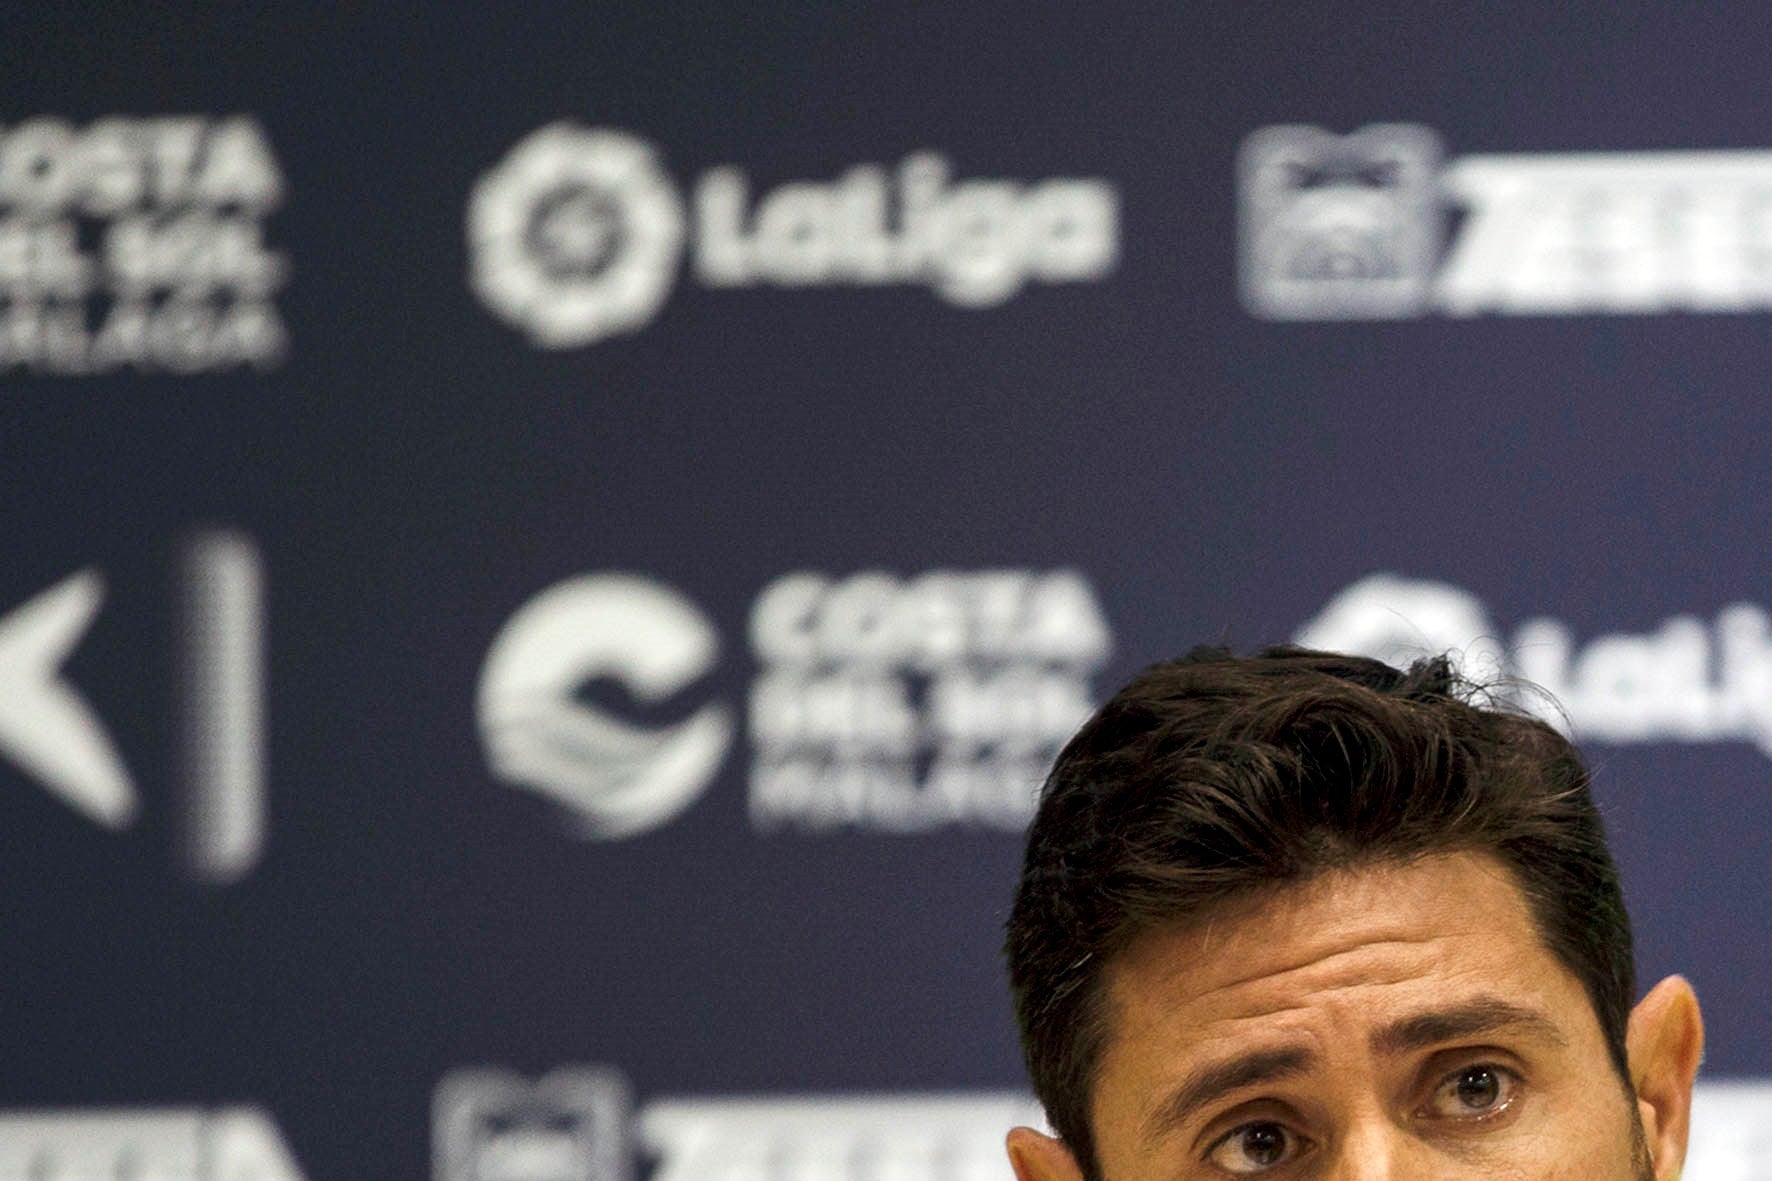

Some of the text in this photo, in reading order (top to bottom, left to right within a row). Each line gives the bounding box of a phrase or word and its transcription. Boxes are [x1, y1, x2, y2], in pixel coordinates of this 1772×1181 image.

[0, 117, 282, 207] OSTA
[692, 153, 1120, 308] LaLiga
[749, 569, 1112, 666] COSTA
